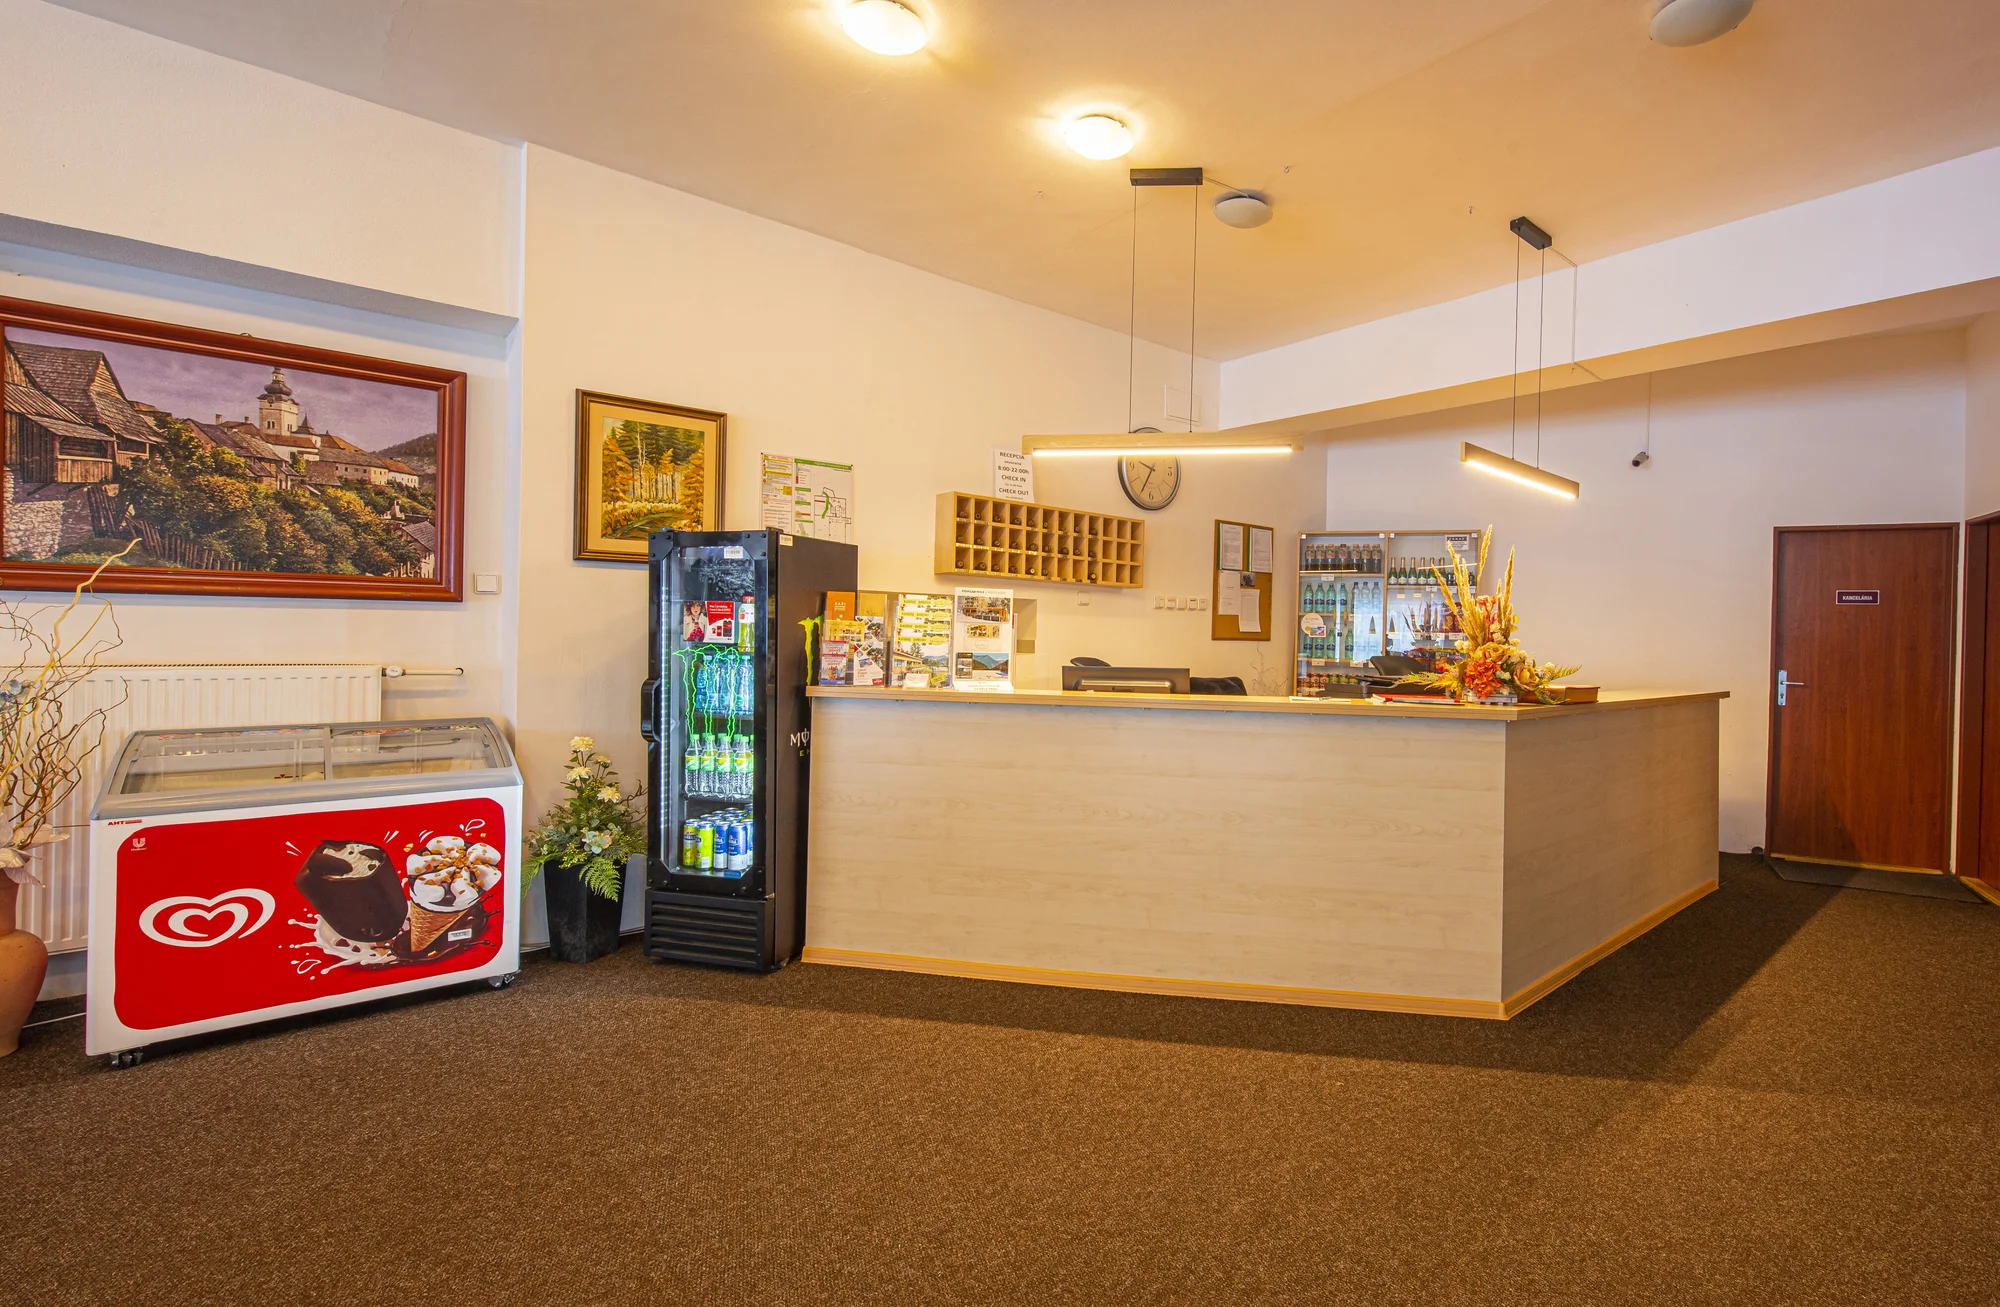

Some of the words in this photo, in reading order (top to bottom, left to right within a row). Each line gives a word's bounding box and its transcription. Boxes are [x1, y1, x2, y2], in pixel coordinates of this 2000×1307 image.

[1000, 452, 1025, 460] RECEPCIA
[1129, 461, 1135, 471] 9
[1167, 466, 1173, 476] 3
[1148, 490, 1154, 500] 6
